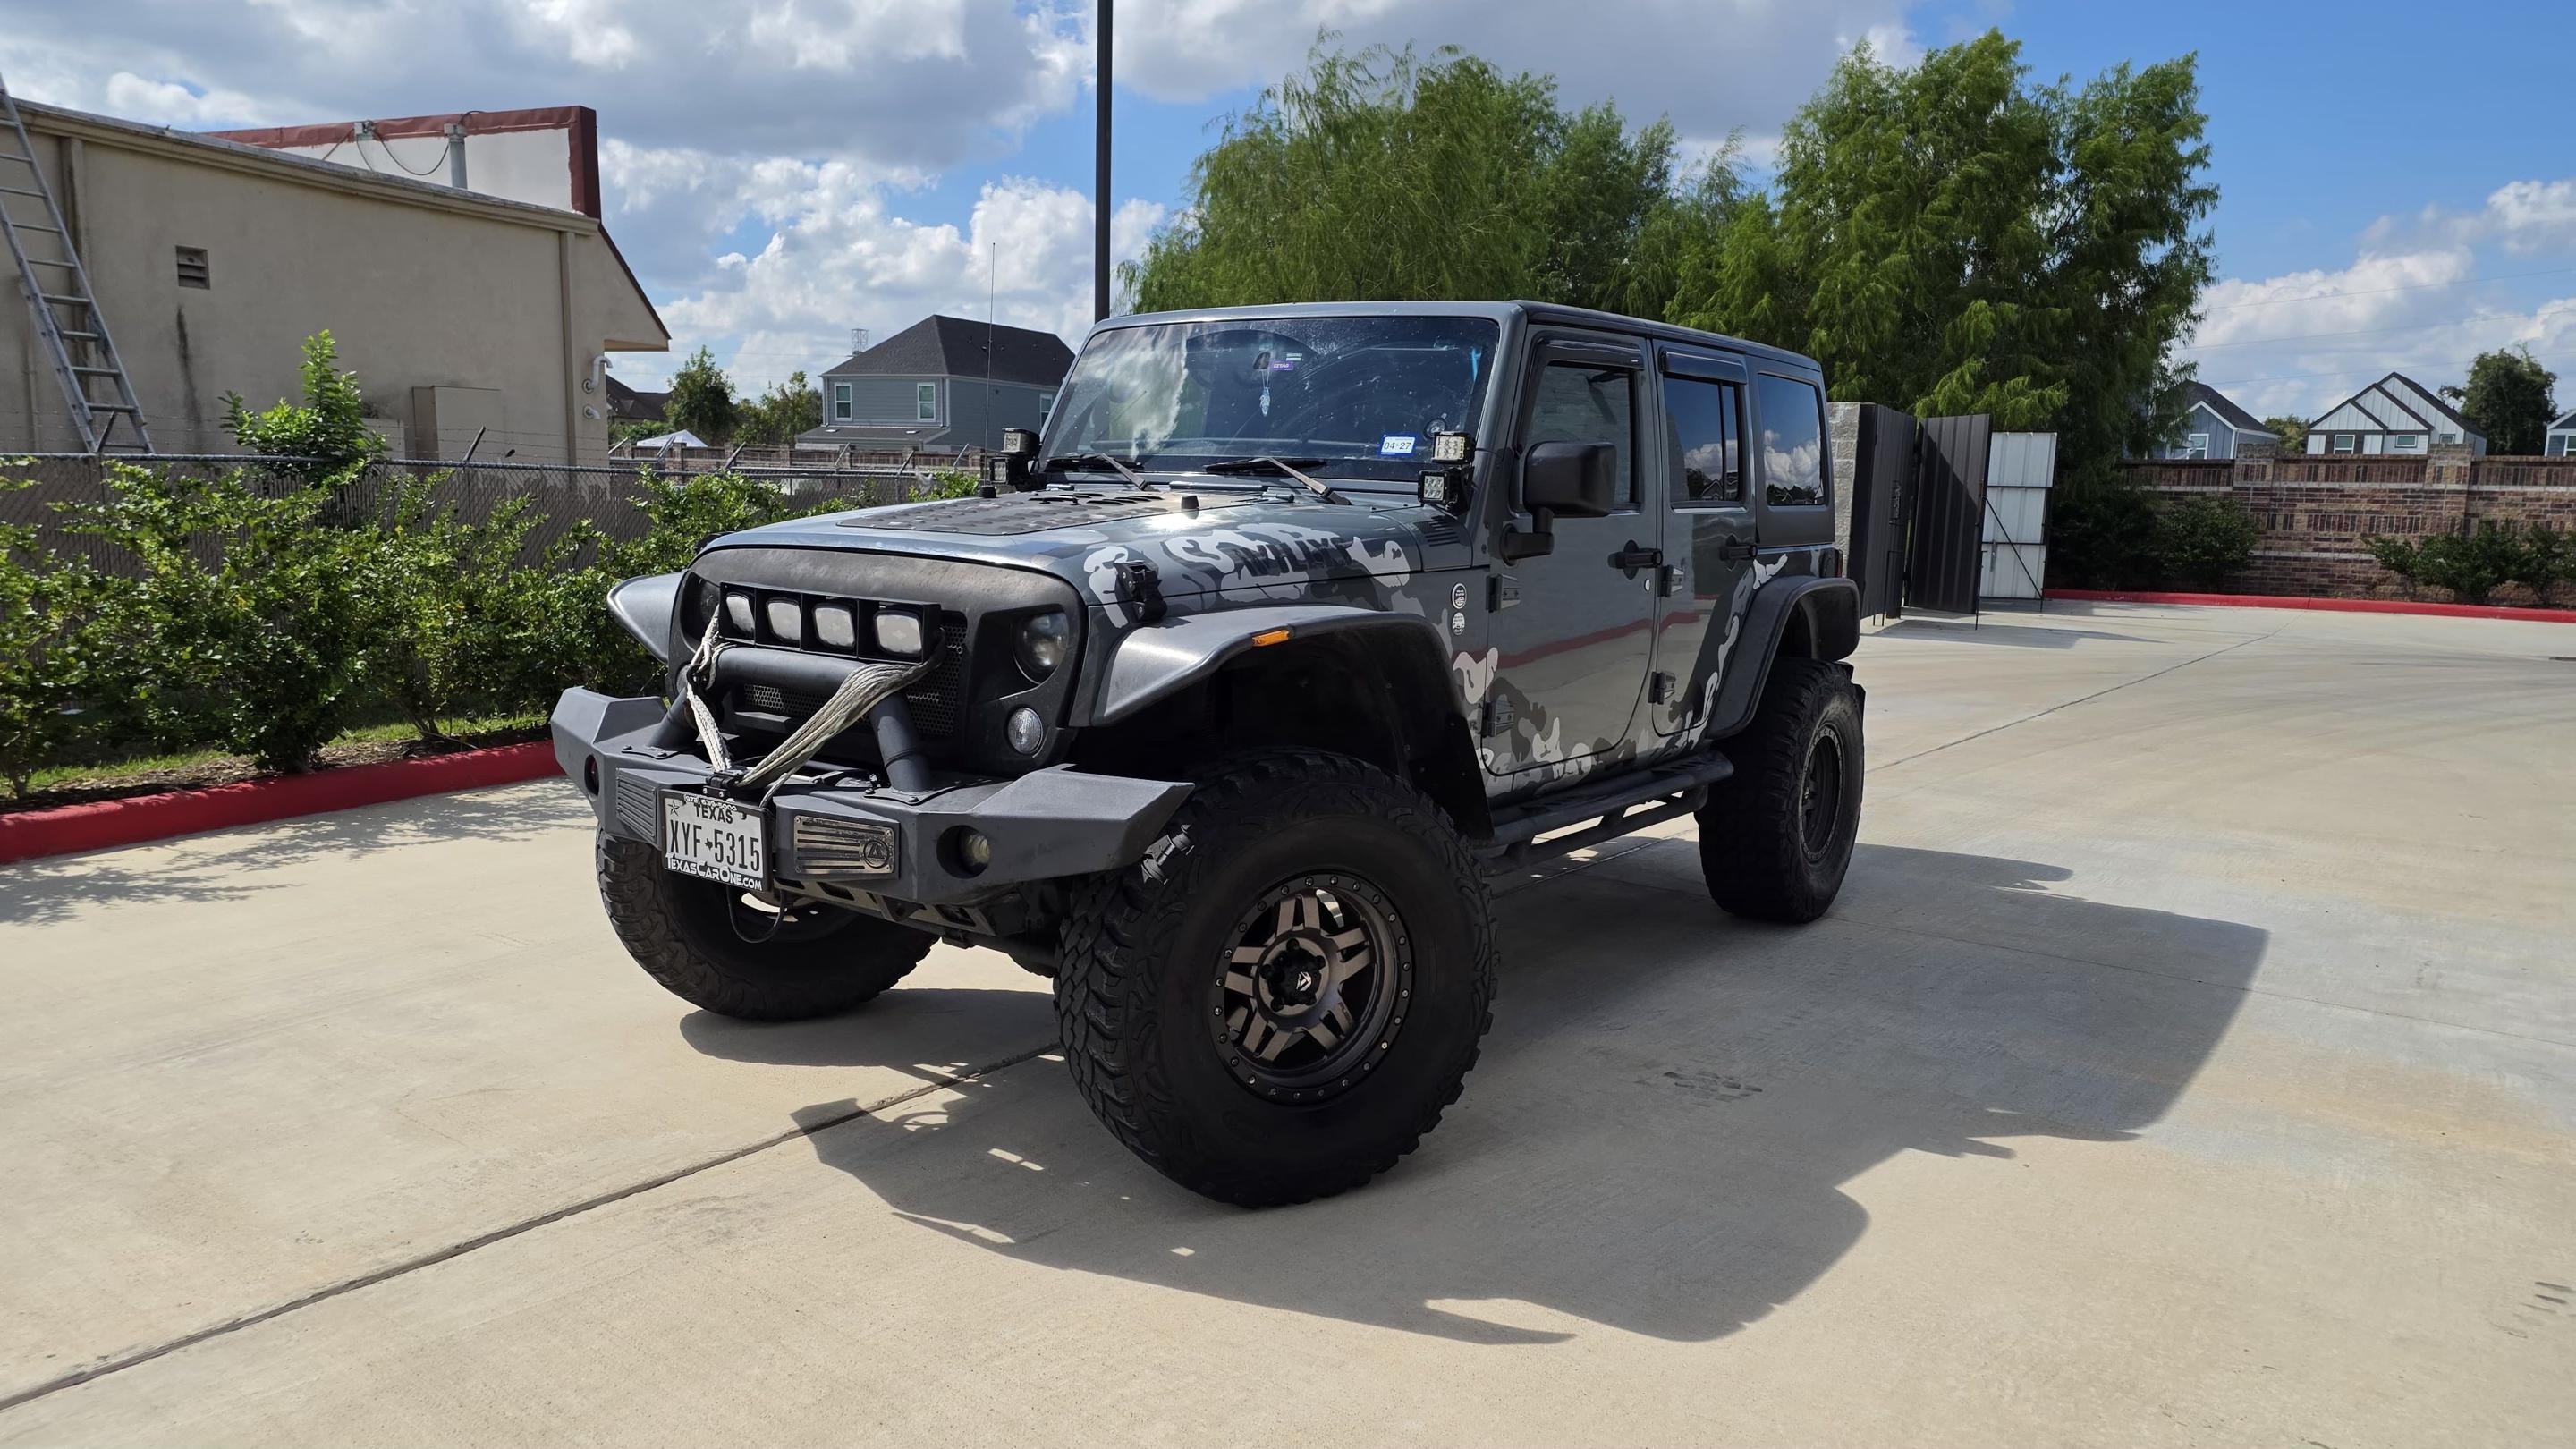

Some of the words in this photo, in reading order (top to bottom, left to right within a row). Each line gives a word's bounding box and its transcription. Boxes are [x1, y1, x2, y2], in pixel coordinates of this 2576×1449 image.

[1236, 537, 1353, 577] WILLYS
[694, 804, 733, 824] TEXAS
[670, 819, 702, 858] XYF
[714, 829, 760, 872] 5315
